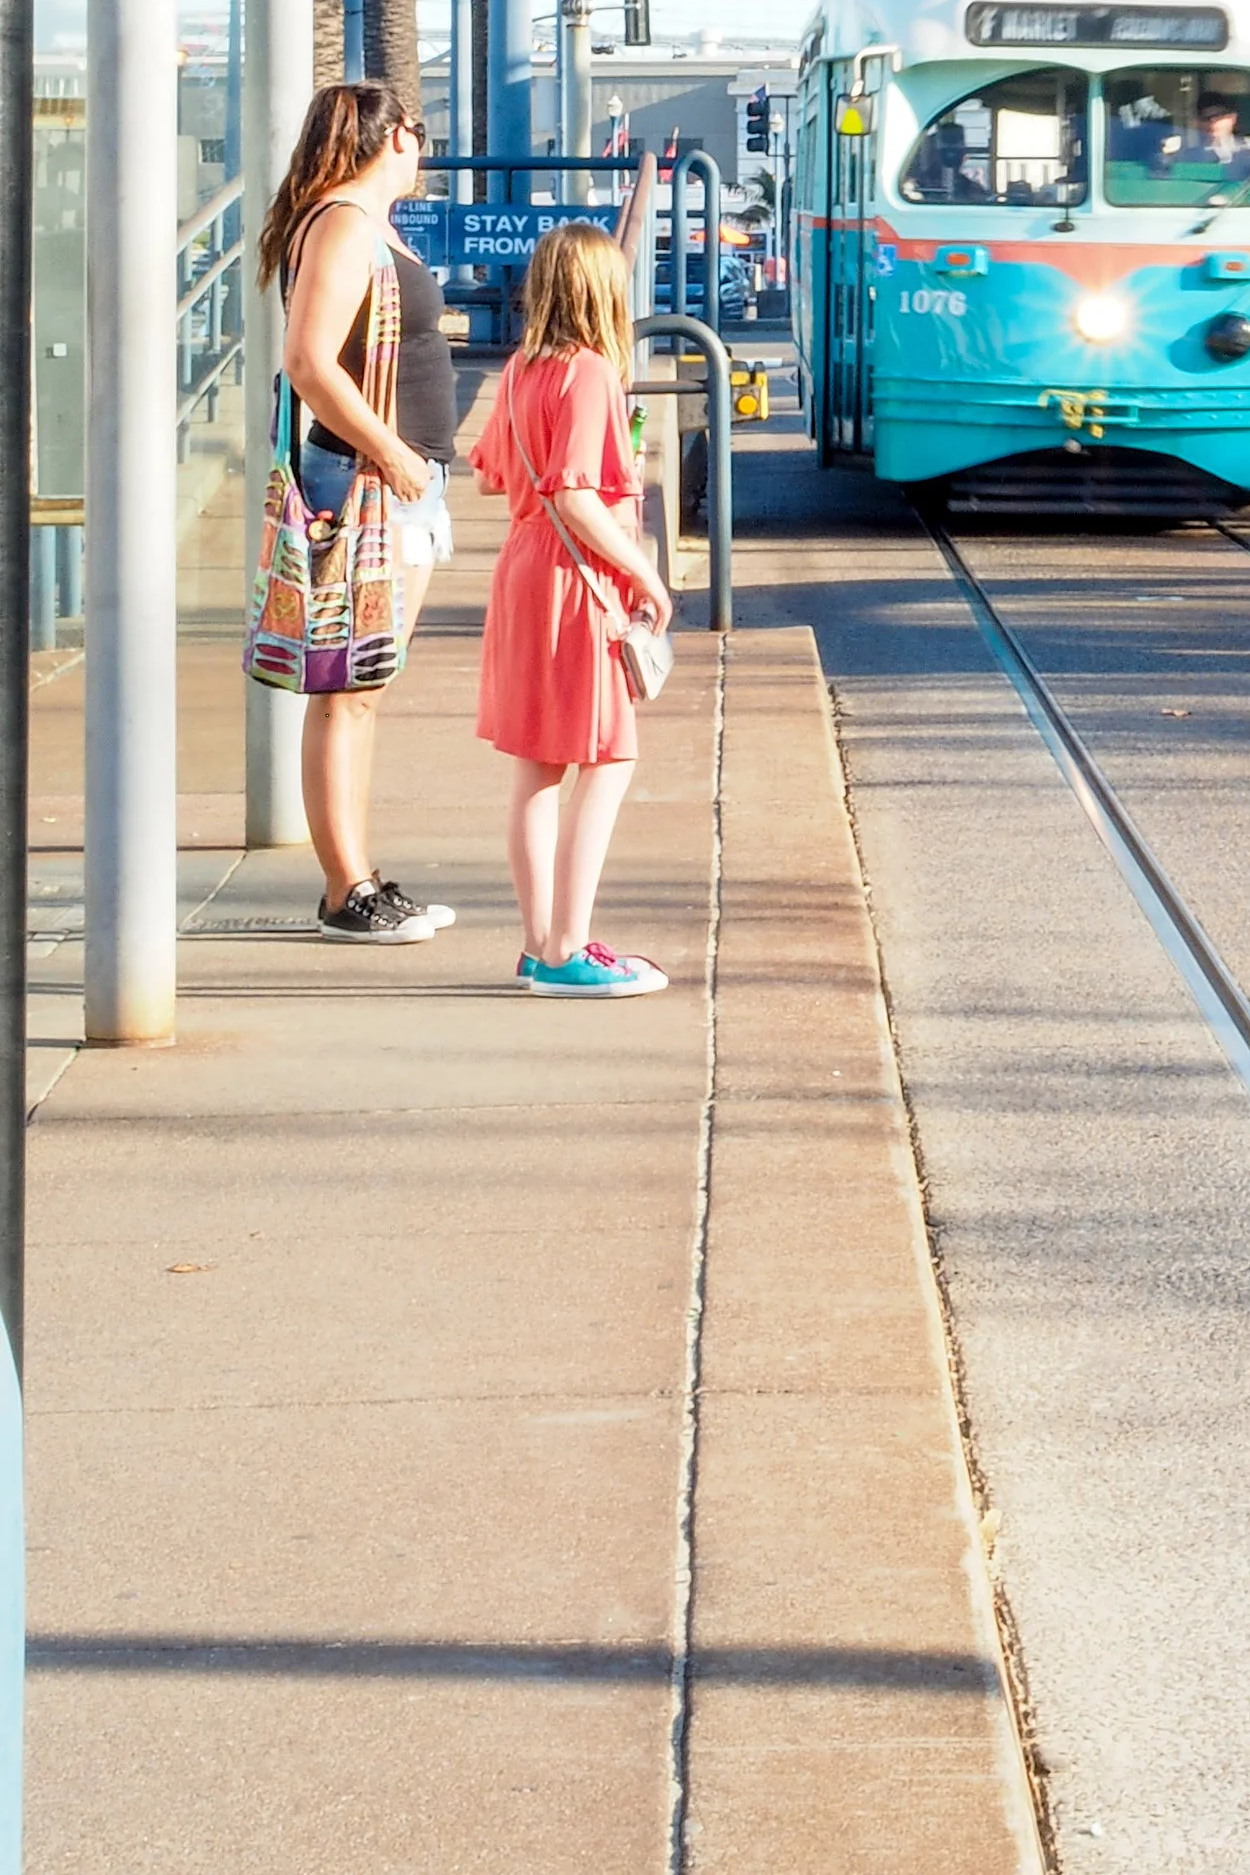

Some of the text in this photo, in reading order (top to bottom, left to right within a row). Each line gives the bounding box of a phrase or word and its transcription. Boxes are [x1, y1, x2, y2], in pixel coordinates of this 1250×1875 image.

[391, 214, 438, 225] INBOUND
[464, 215, 529, 232] STAY
[464, 237, 534, 254] FROM
[900, 290, 967, 316] 1076
